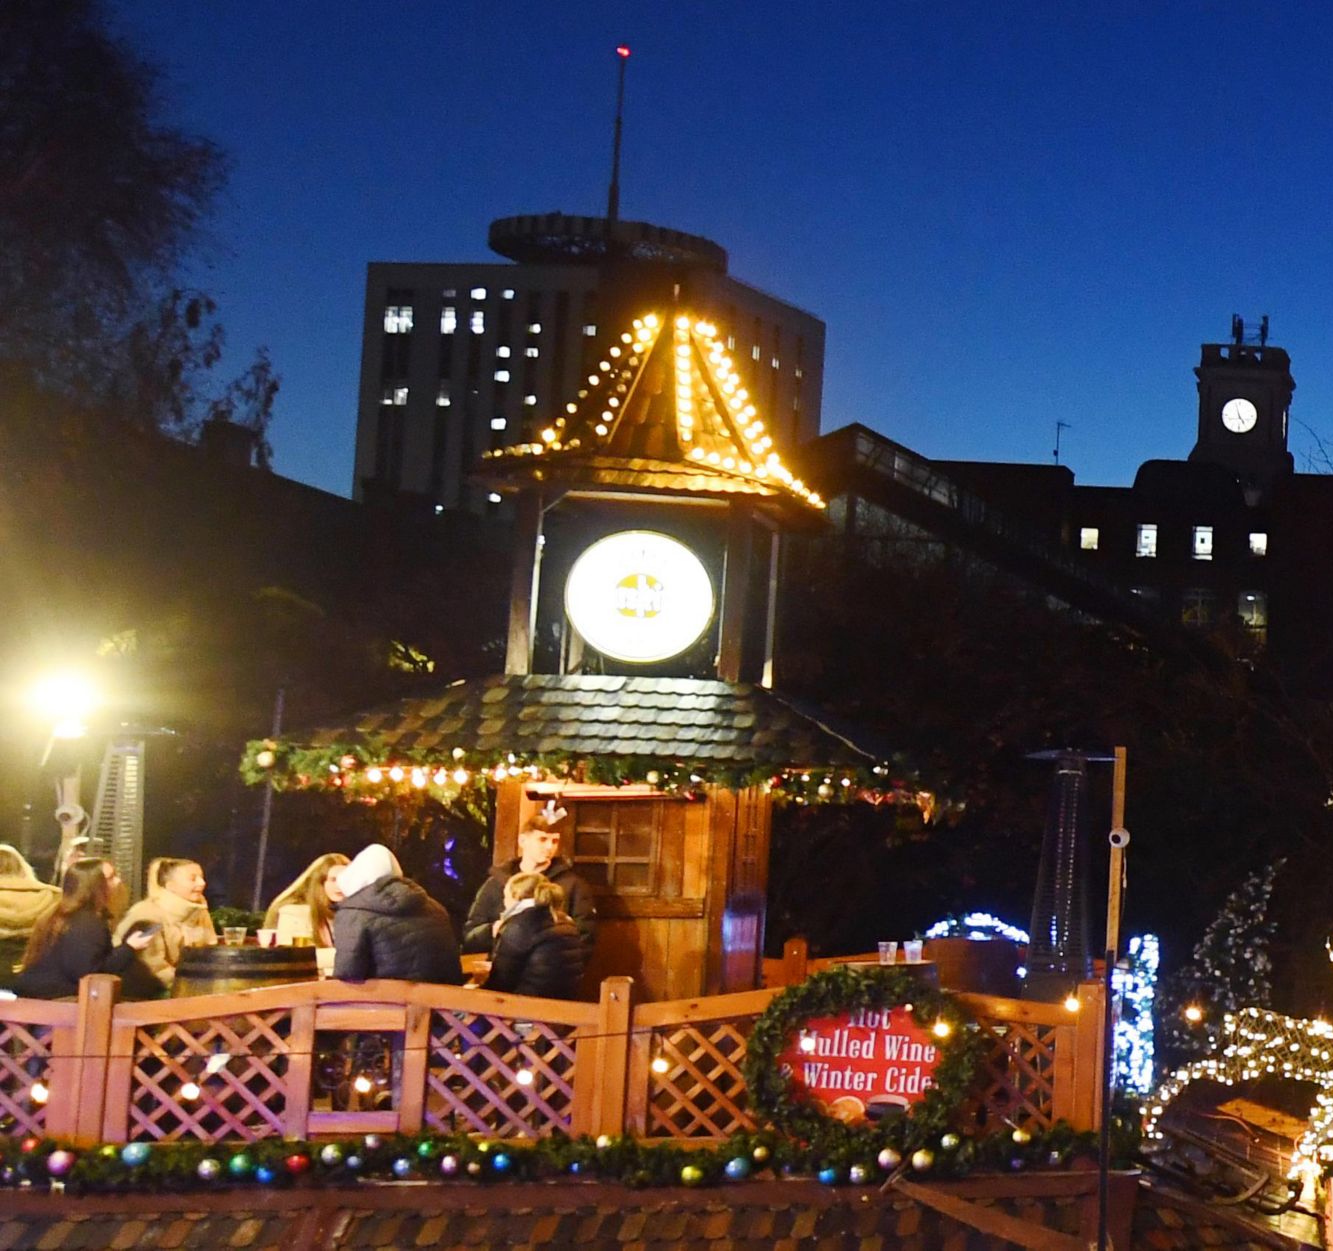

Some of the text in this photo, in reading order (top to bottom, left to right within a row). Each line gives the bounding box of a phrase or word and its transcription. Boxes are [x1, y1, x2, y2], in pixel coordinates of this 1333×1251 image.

[848, 1007, 891, 1030] Hot
[797, 1029, 936, 1062] Mulled Wine
[804, 1062, 939, 1093] Winter Cide
